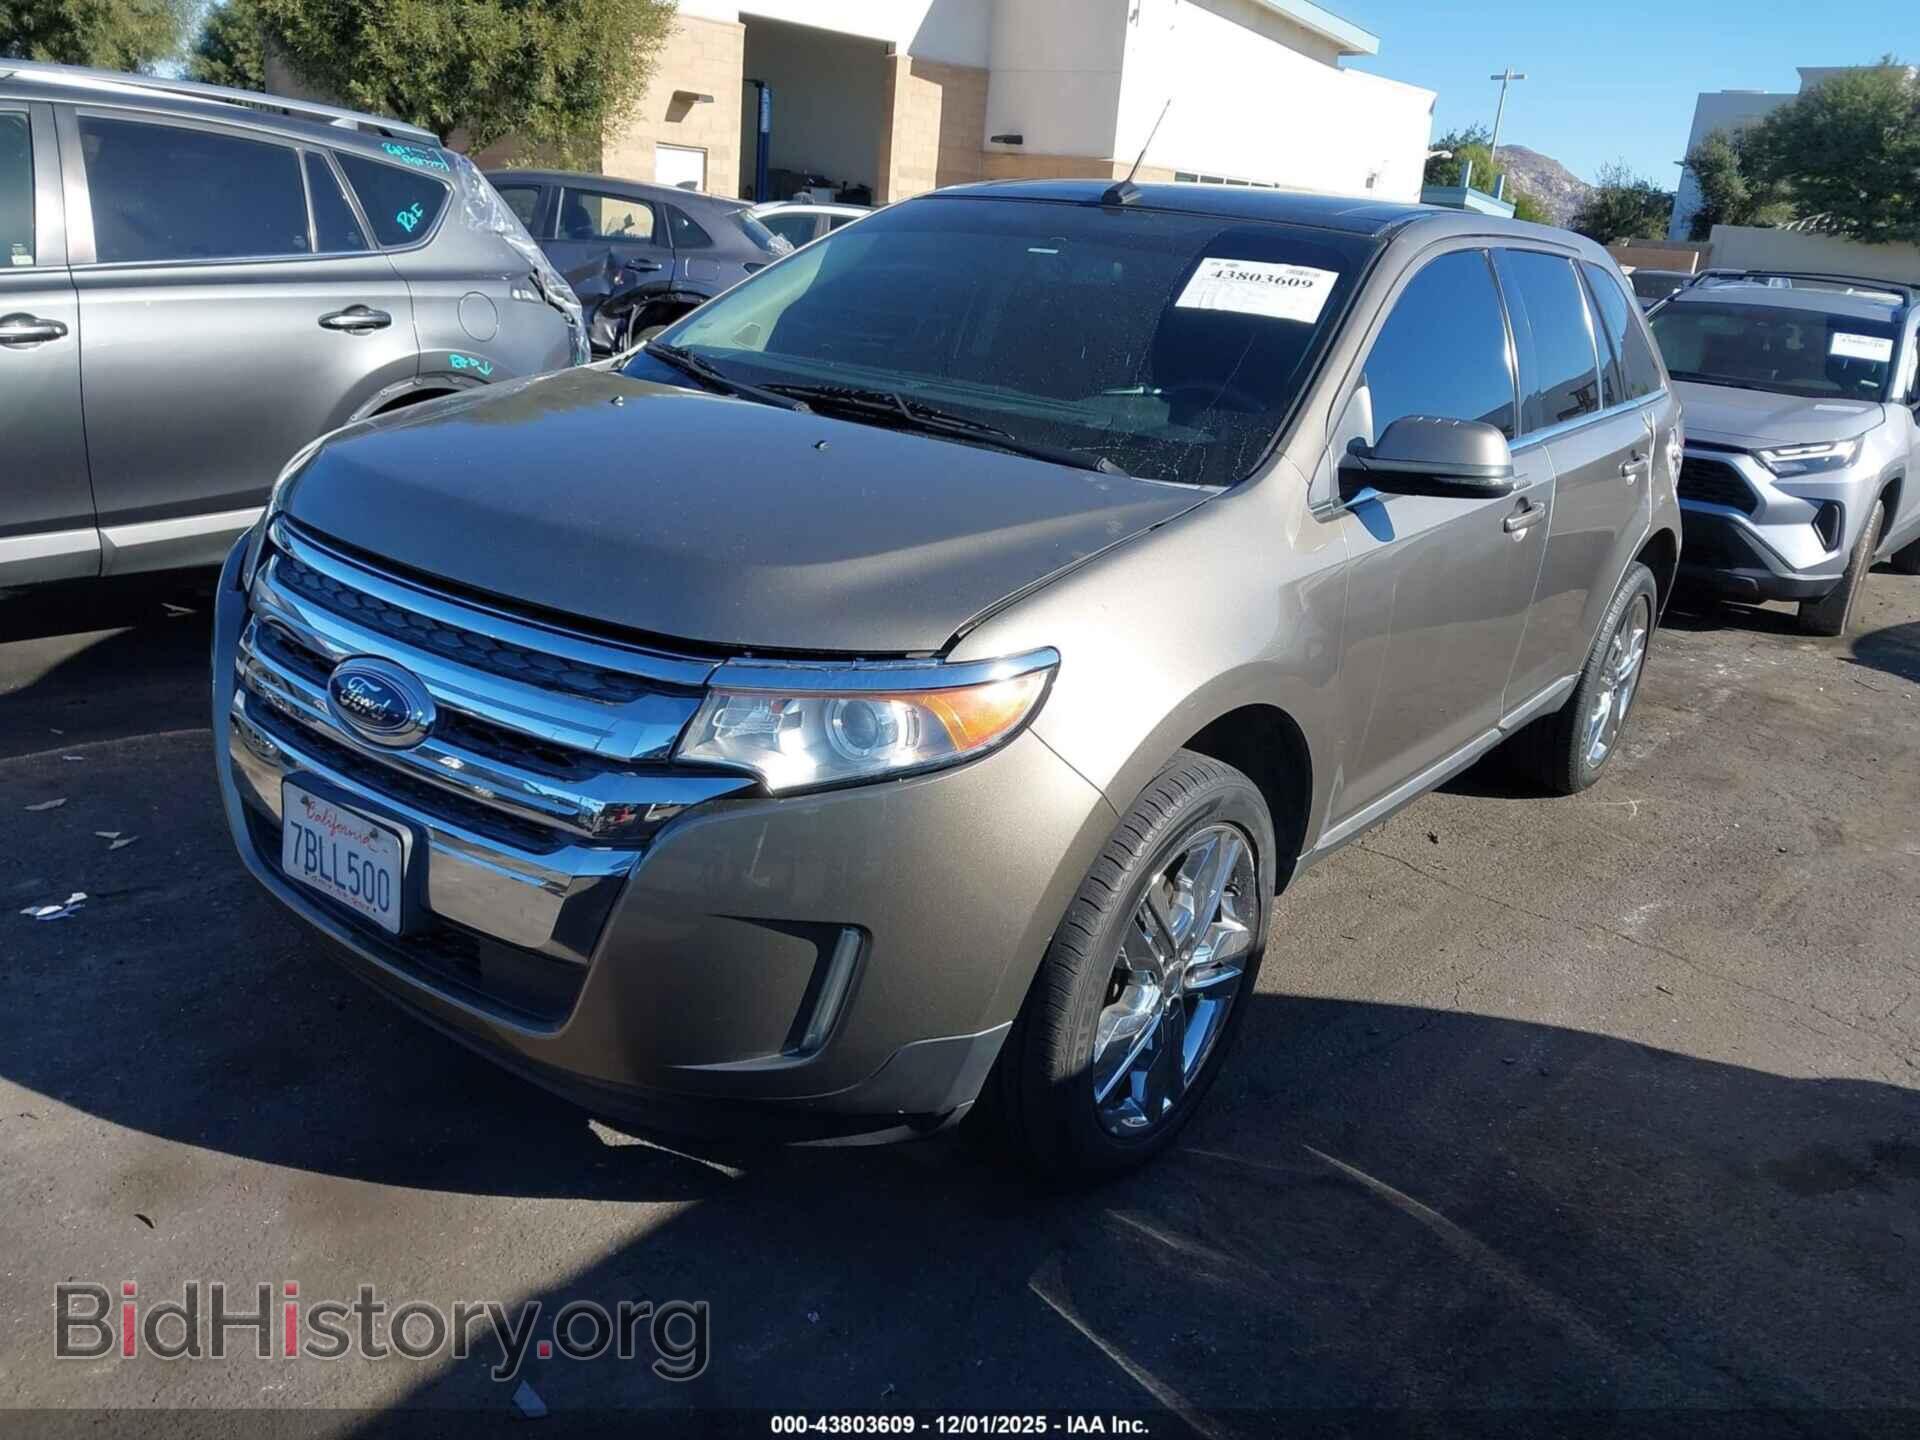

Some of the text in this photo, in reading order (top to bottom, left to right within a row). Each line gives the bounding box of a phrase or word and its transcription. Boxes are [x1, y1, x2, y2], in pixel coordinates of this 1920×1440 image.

[1210, 269, 1315, 289] 43803609
[340, 676, 391, 716] Ford
[306, 800, 370, 843] California
[290, 820, 391, 913] 7BLL500
